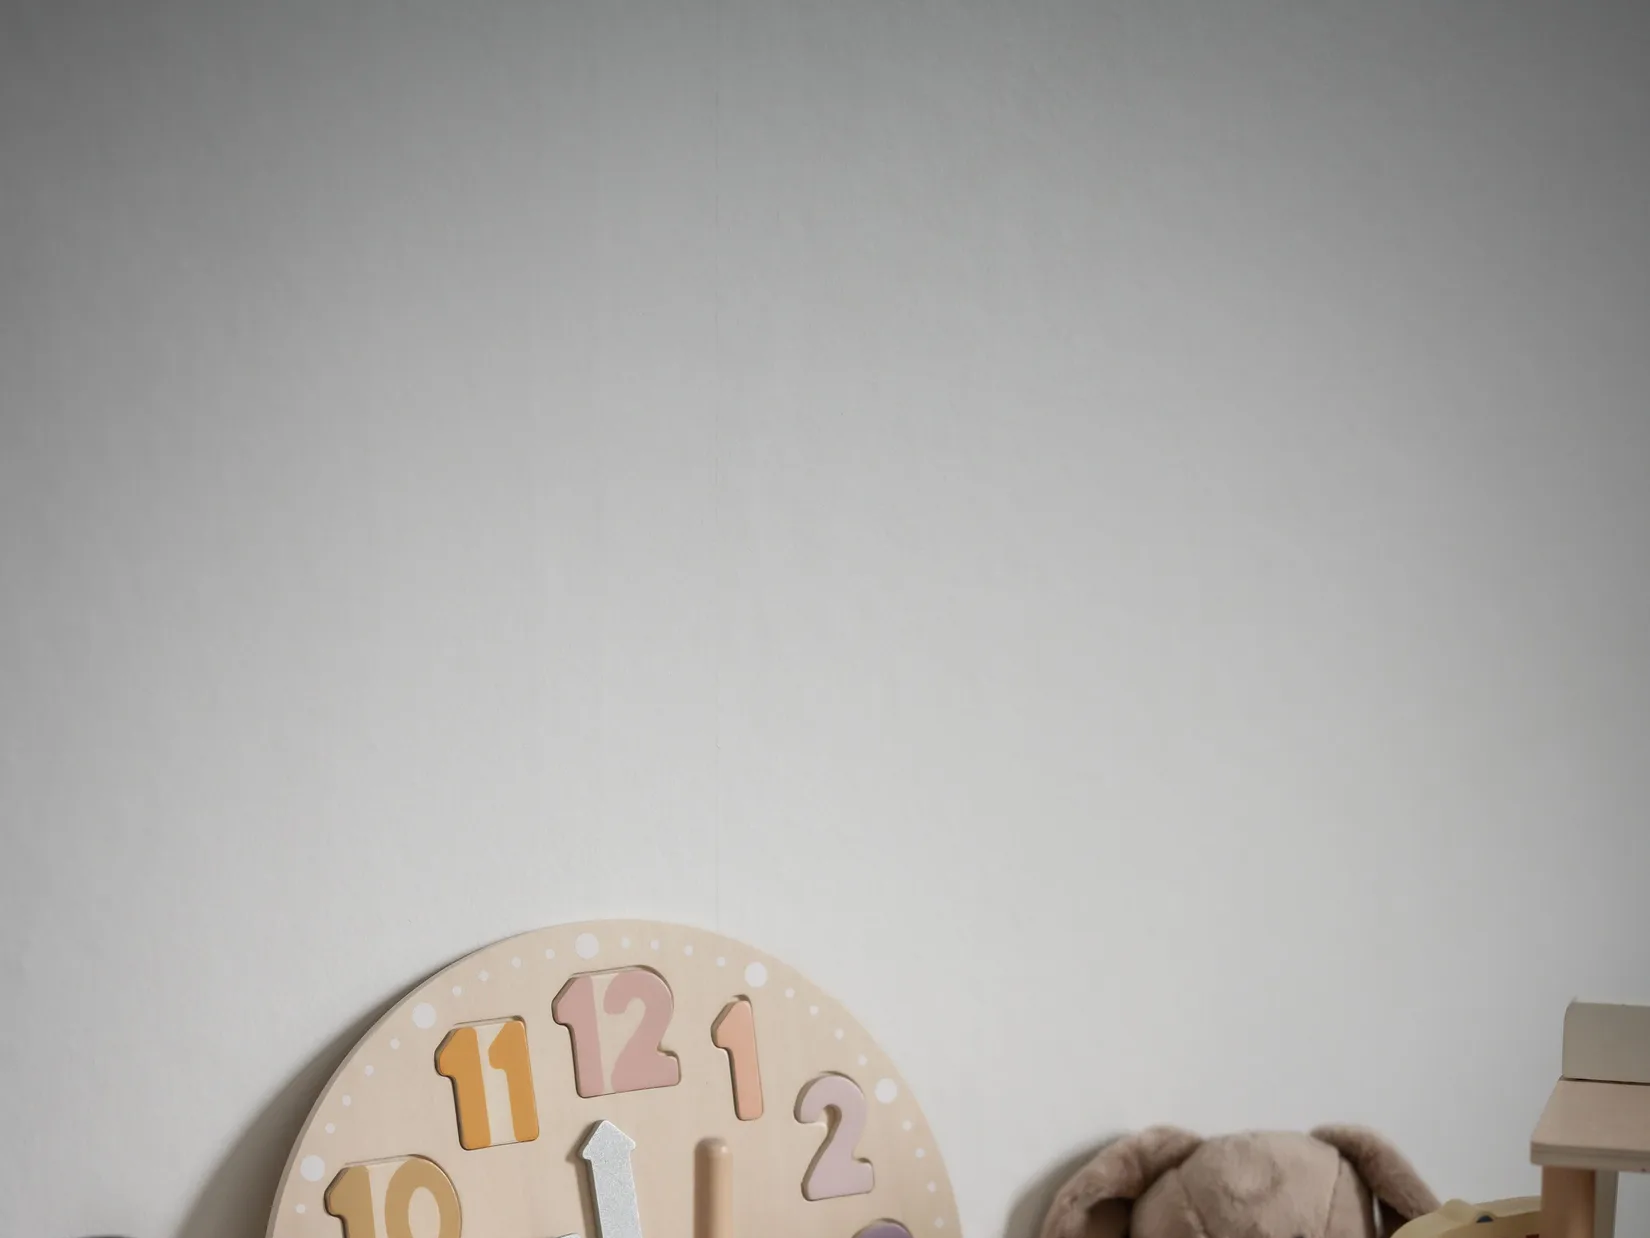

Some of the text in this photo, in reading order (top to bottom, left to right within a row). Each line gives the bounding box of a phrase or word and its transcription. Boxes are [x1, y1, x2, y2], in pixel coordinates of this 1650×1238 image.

[435, 1019, 539, 1149] 11
[554, 966, 680, 1096] 12
[712, 998, 763, 1120] 1
[795, 1074, 873, 1200] 2
